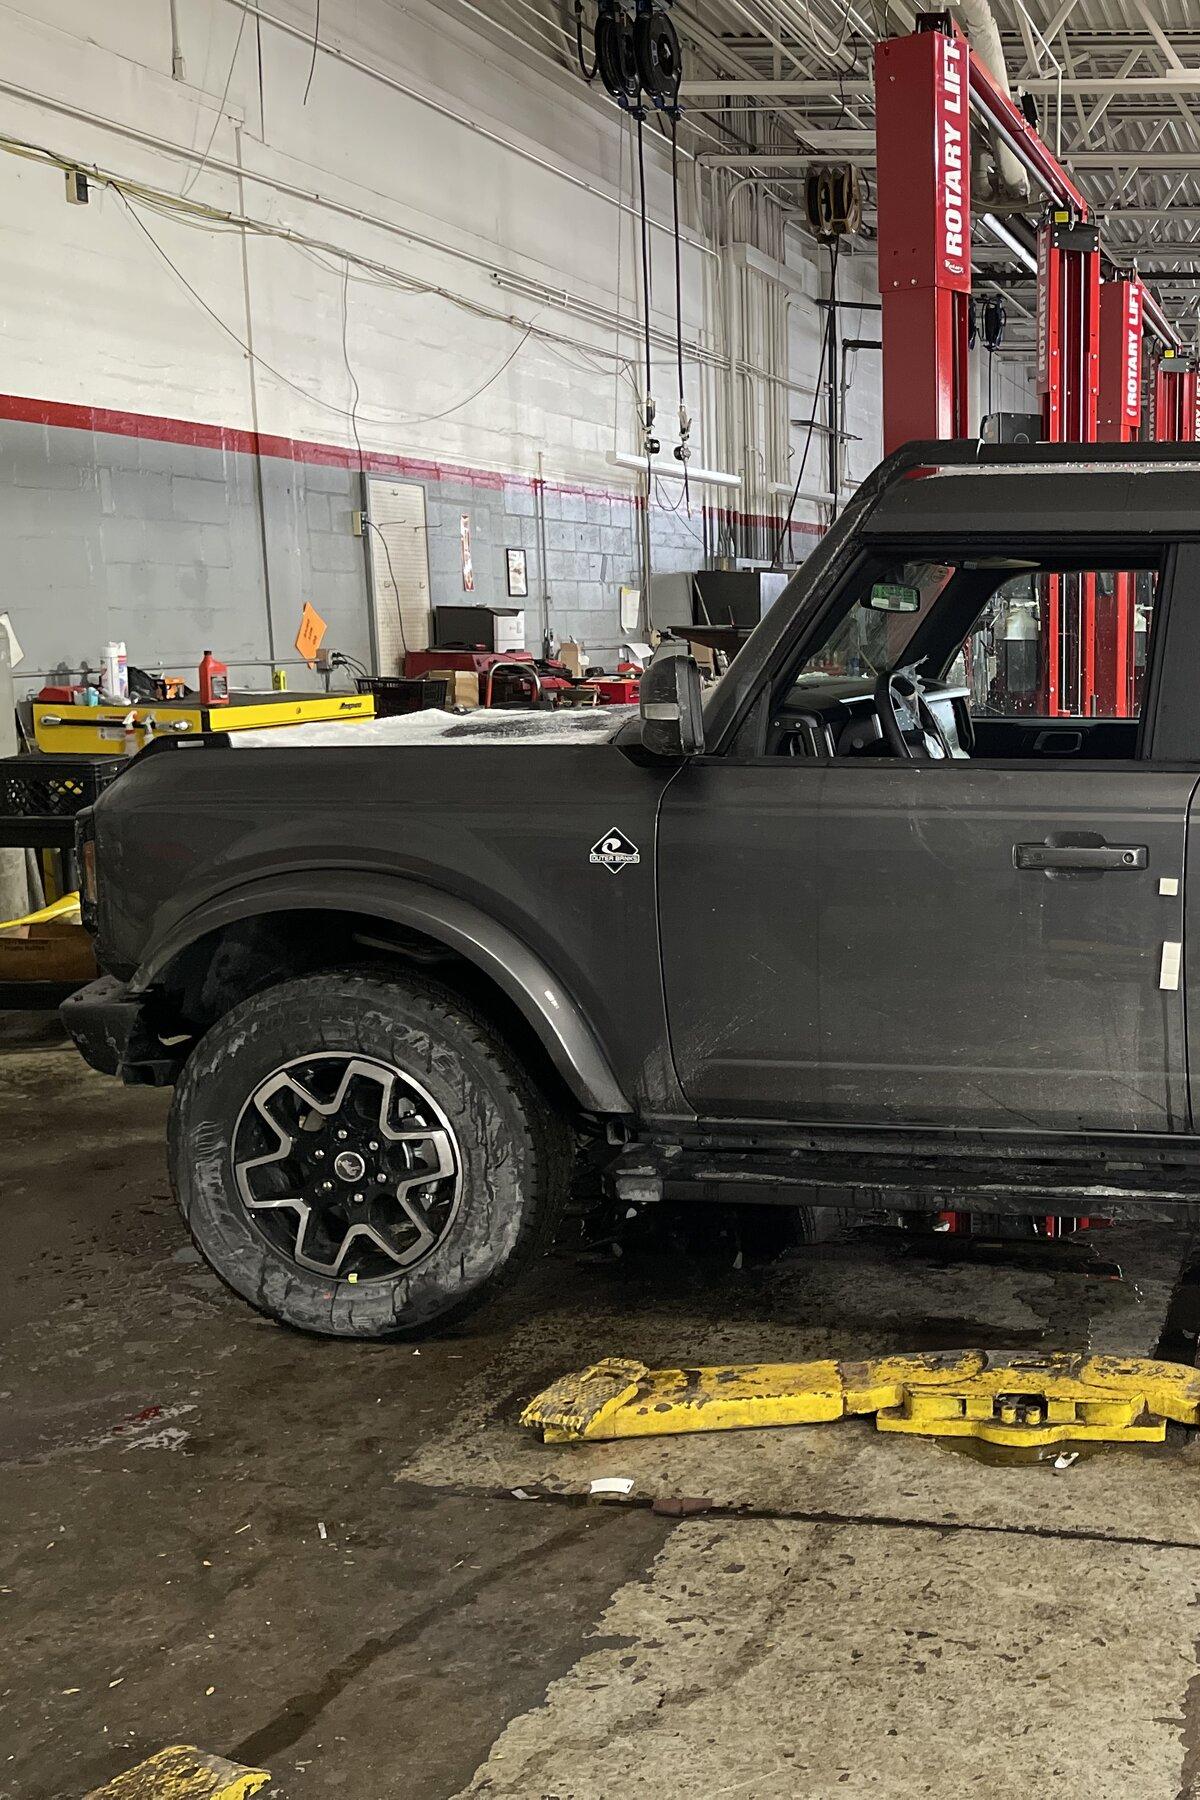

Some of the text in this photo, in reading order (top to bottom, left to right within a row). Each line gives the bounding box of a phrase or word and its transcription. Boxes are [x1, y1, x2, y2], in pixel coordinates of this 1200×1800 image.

[943, 38, 963, 257] ROTARY LIFT
[1038, 284, 1047, 371] ROTARY
[1127, 283, 1141, 407] ROTARY LIFT
